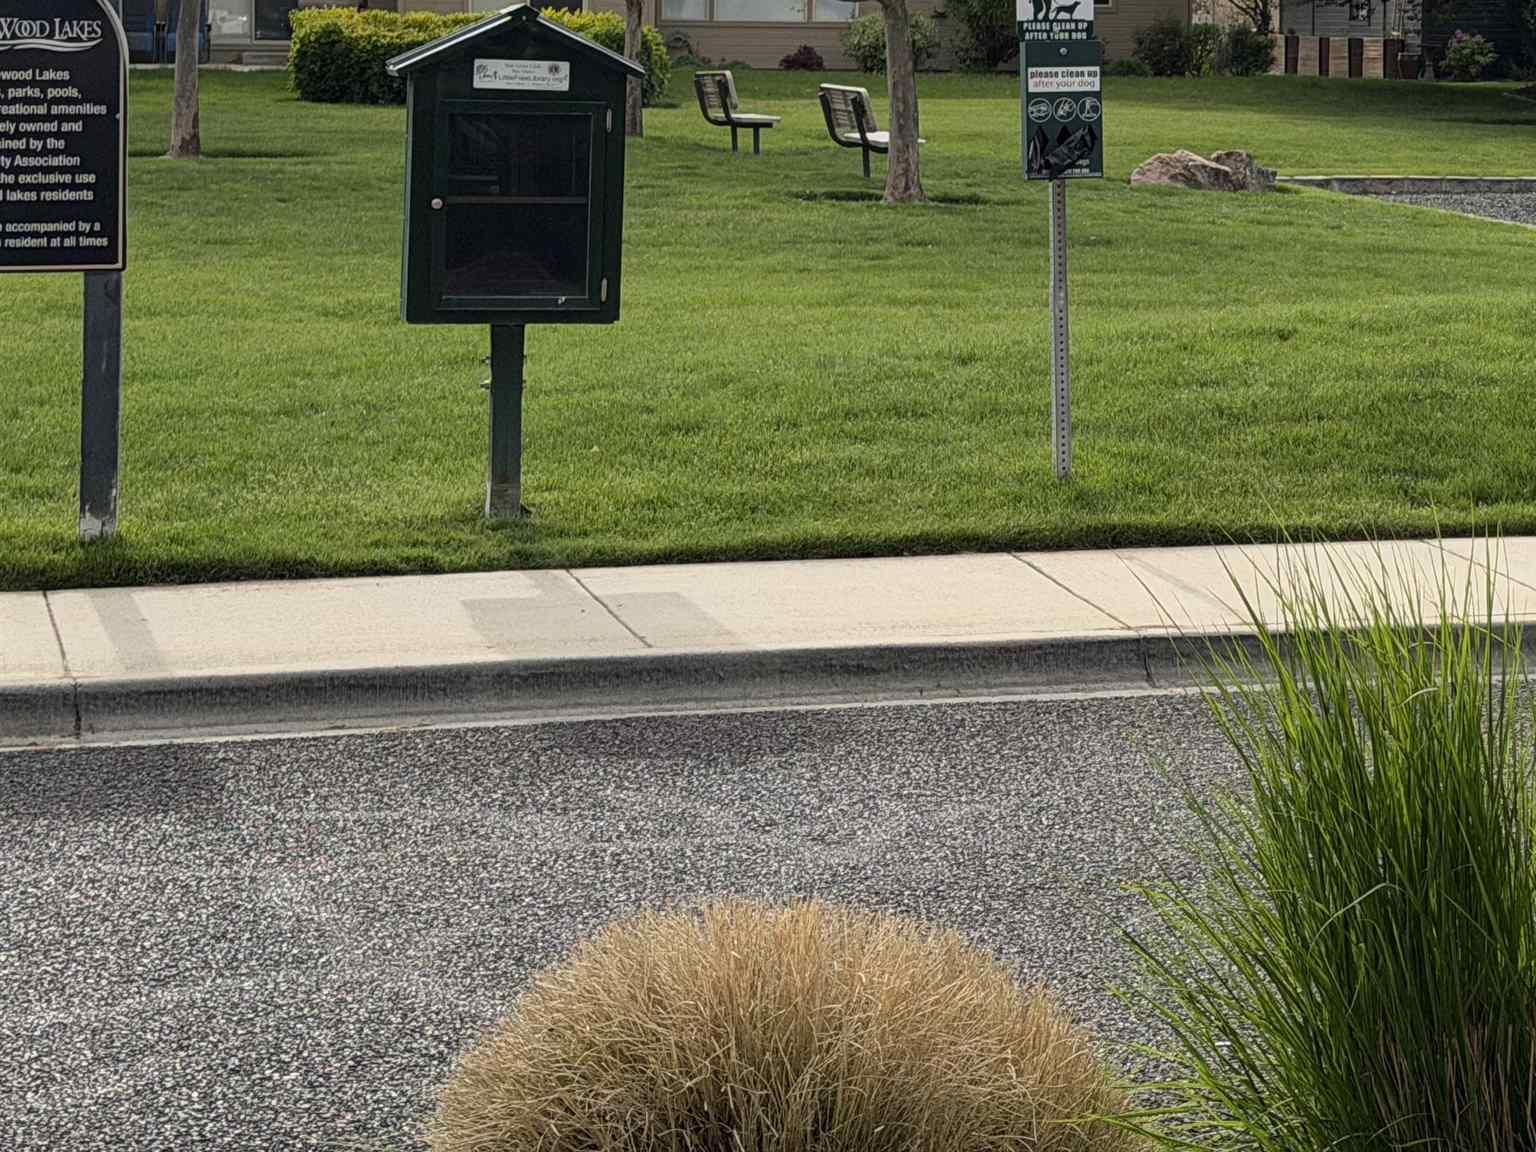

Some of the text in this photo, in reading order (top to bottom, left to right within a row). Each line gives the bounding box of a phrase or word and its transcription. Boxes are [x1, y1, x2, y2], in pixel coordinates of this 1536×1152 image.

[0, 17, 102, 41] WOOD LAKES
[1023, 22, 1088, 31] PLEASE CLEAN UP
[0, 68, 71, 81] wood Lakes
[1030, 69, 1098, 79] please clean up
[1033, 79, 1095, 89] after your dog
[7, 86, 44, 100] parks,
[47, 86, 82, 100] pools,
[0, 102, 107, 115] eational amenities
[18, 120, 58, 132] owned
[60, 120, 83, 132] and
[0, 137, 65, 152] ined by the
[14, 154, 81, 166] Association
[18, 171, 72, 184] exclusive
[75, 173, 96, 184] use
[40, 189, 94, 201] residents
[5, 220, 76, 234] accompanied
[78, 220, 92, 234] by
[94, 222, 101, 232] a
[4, 236, 48, 248] resident
[50, 236, 61, 248] at
[63, 236, 76, 247] all
[78, 236, 109, 247] times
